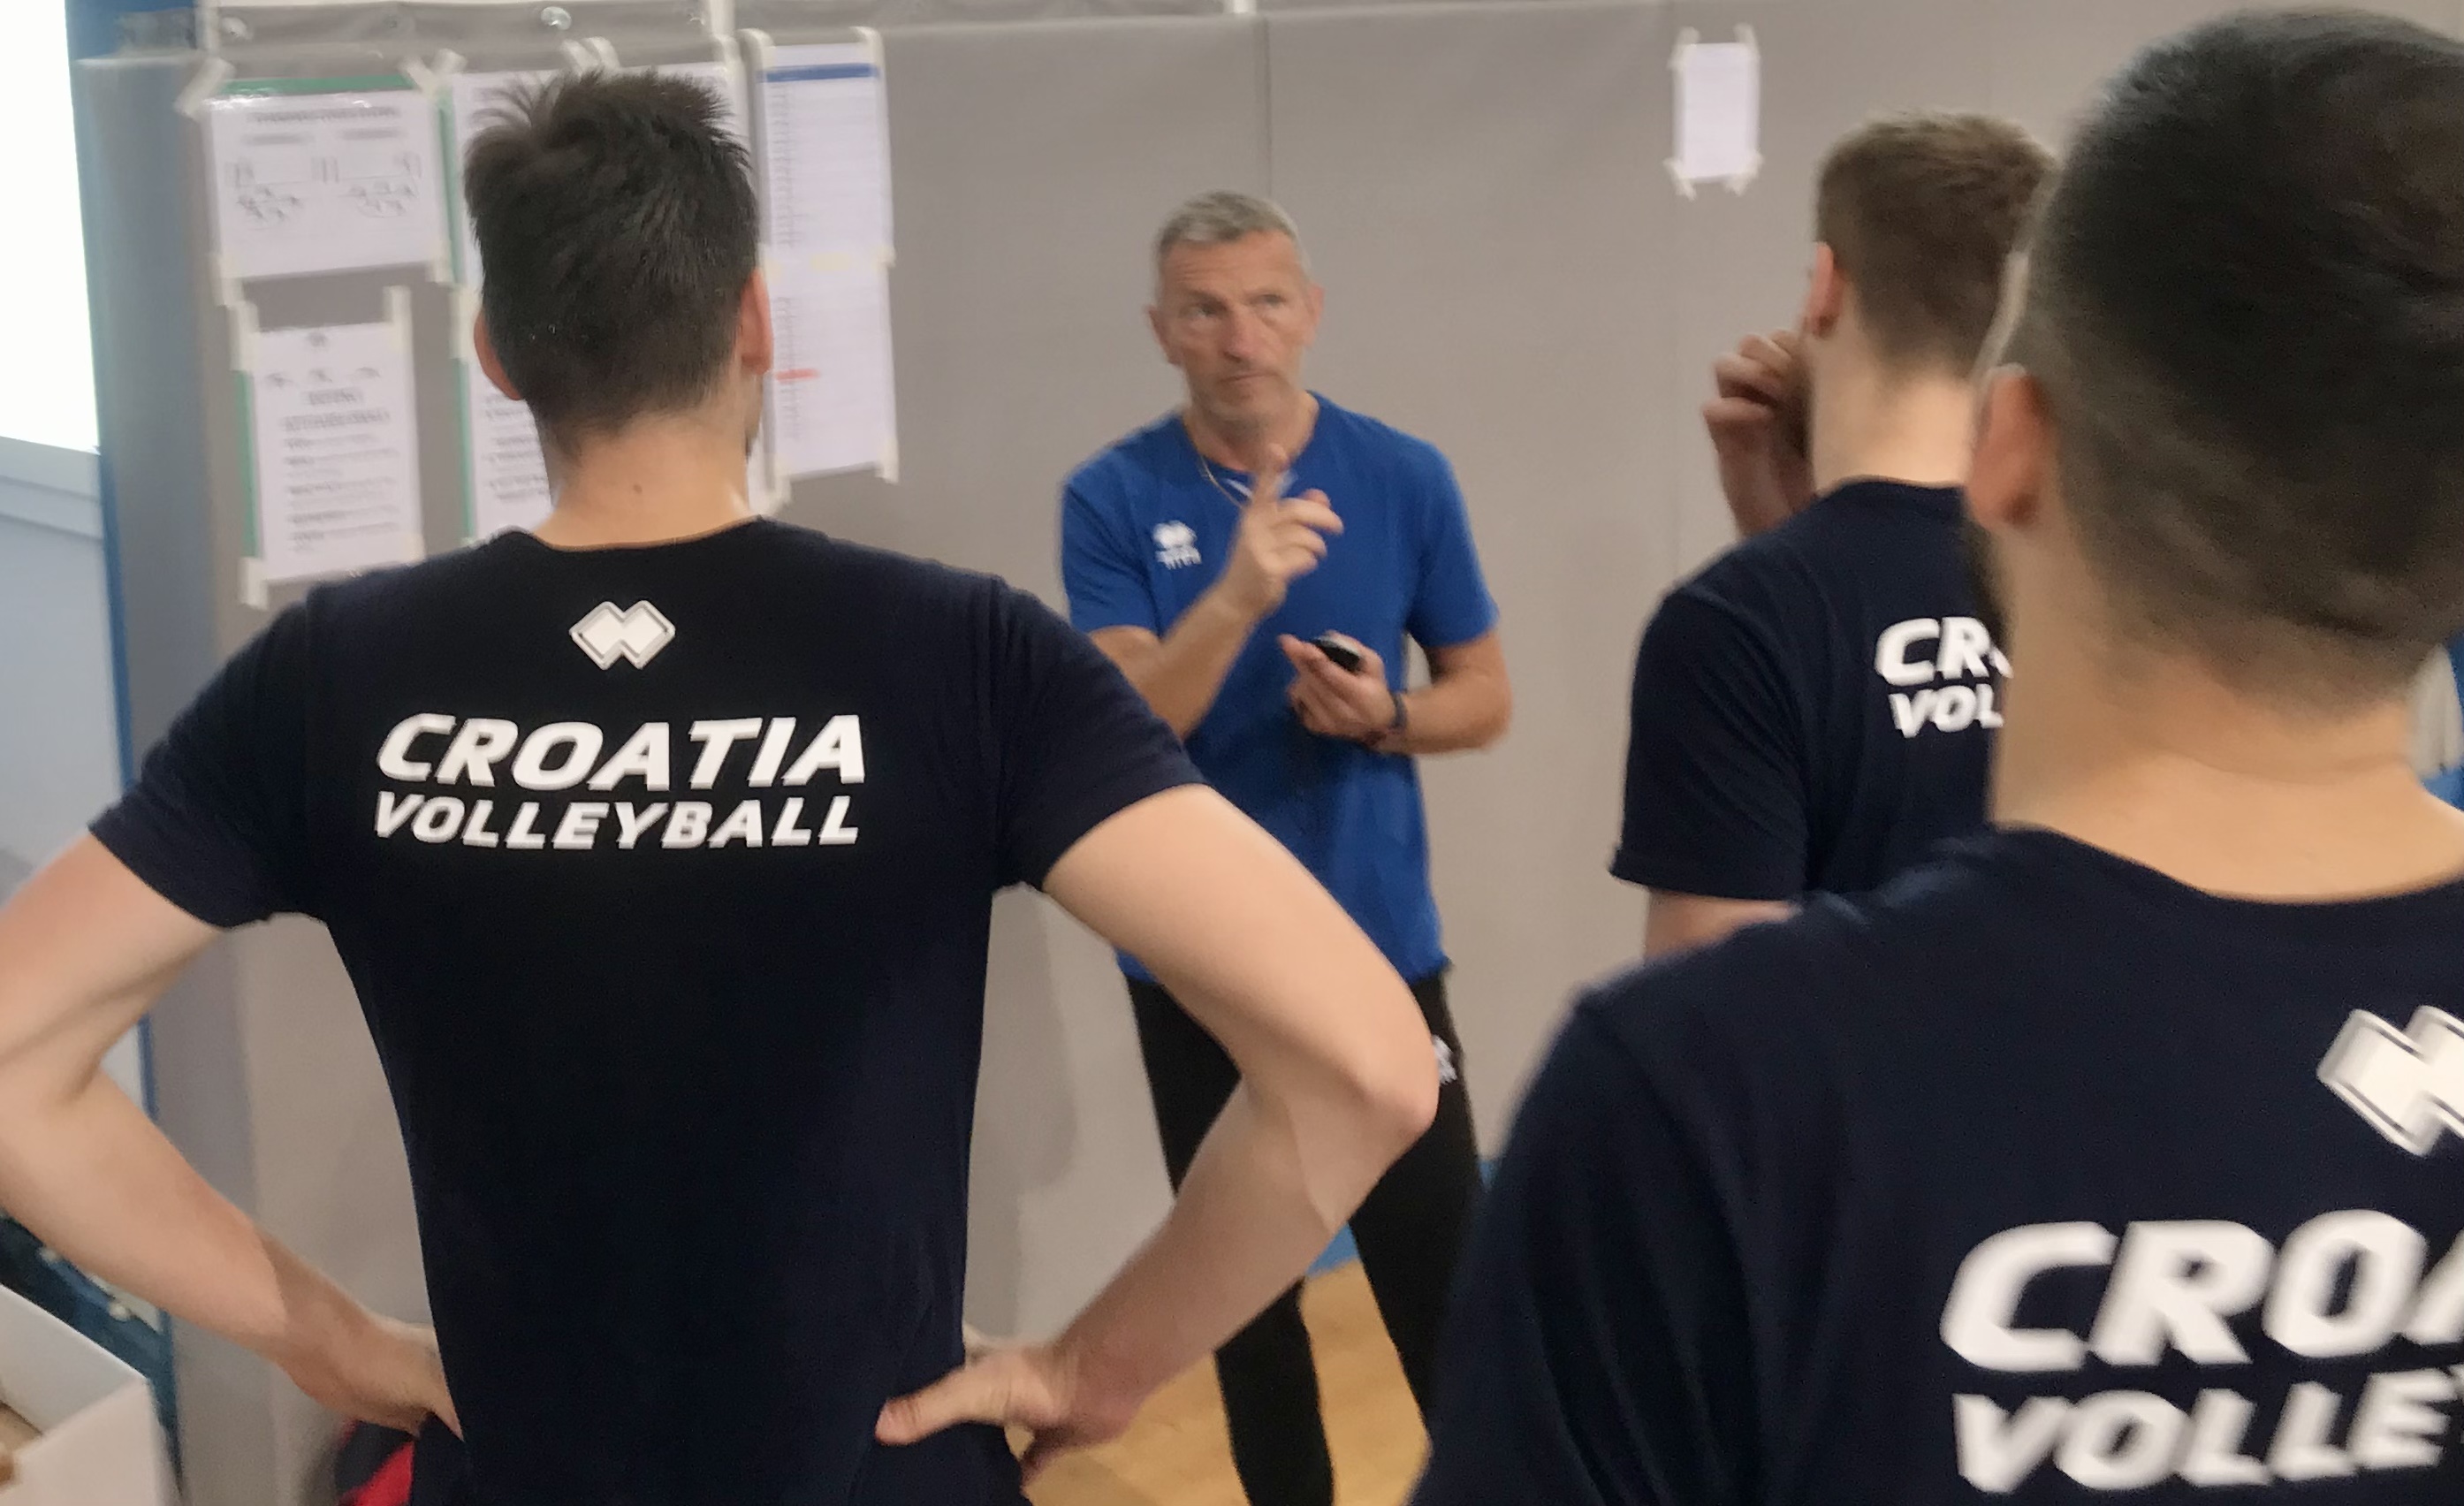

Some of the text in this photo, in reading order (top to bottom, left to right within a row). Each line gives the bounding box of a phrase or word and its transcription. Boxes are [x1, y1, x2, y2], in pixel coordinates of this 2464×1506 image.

[1874, 616, 2014, 686] CR
[376, 712, 865, 791] CROATIA
[375, 790, 858, 849] VOLLEYBALL
[1952, 1365, 2464, 1494] VOLLE
